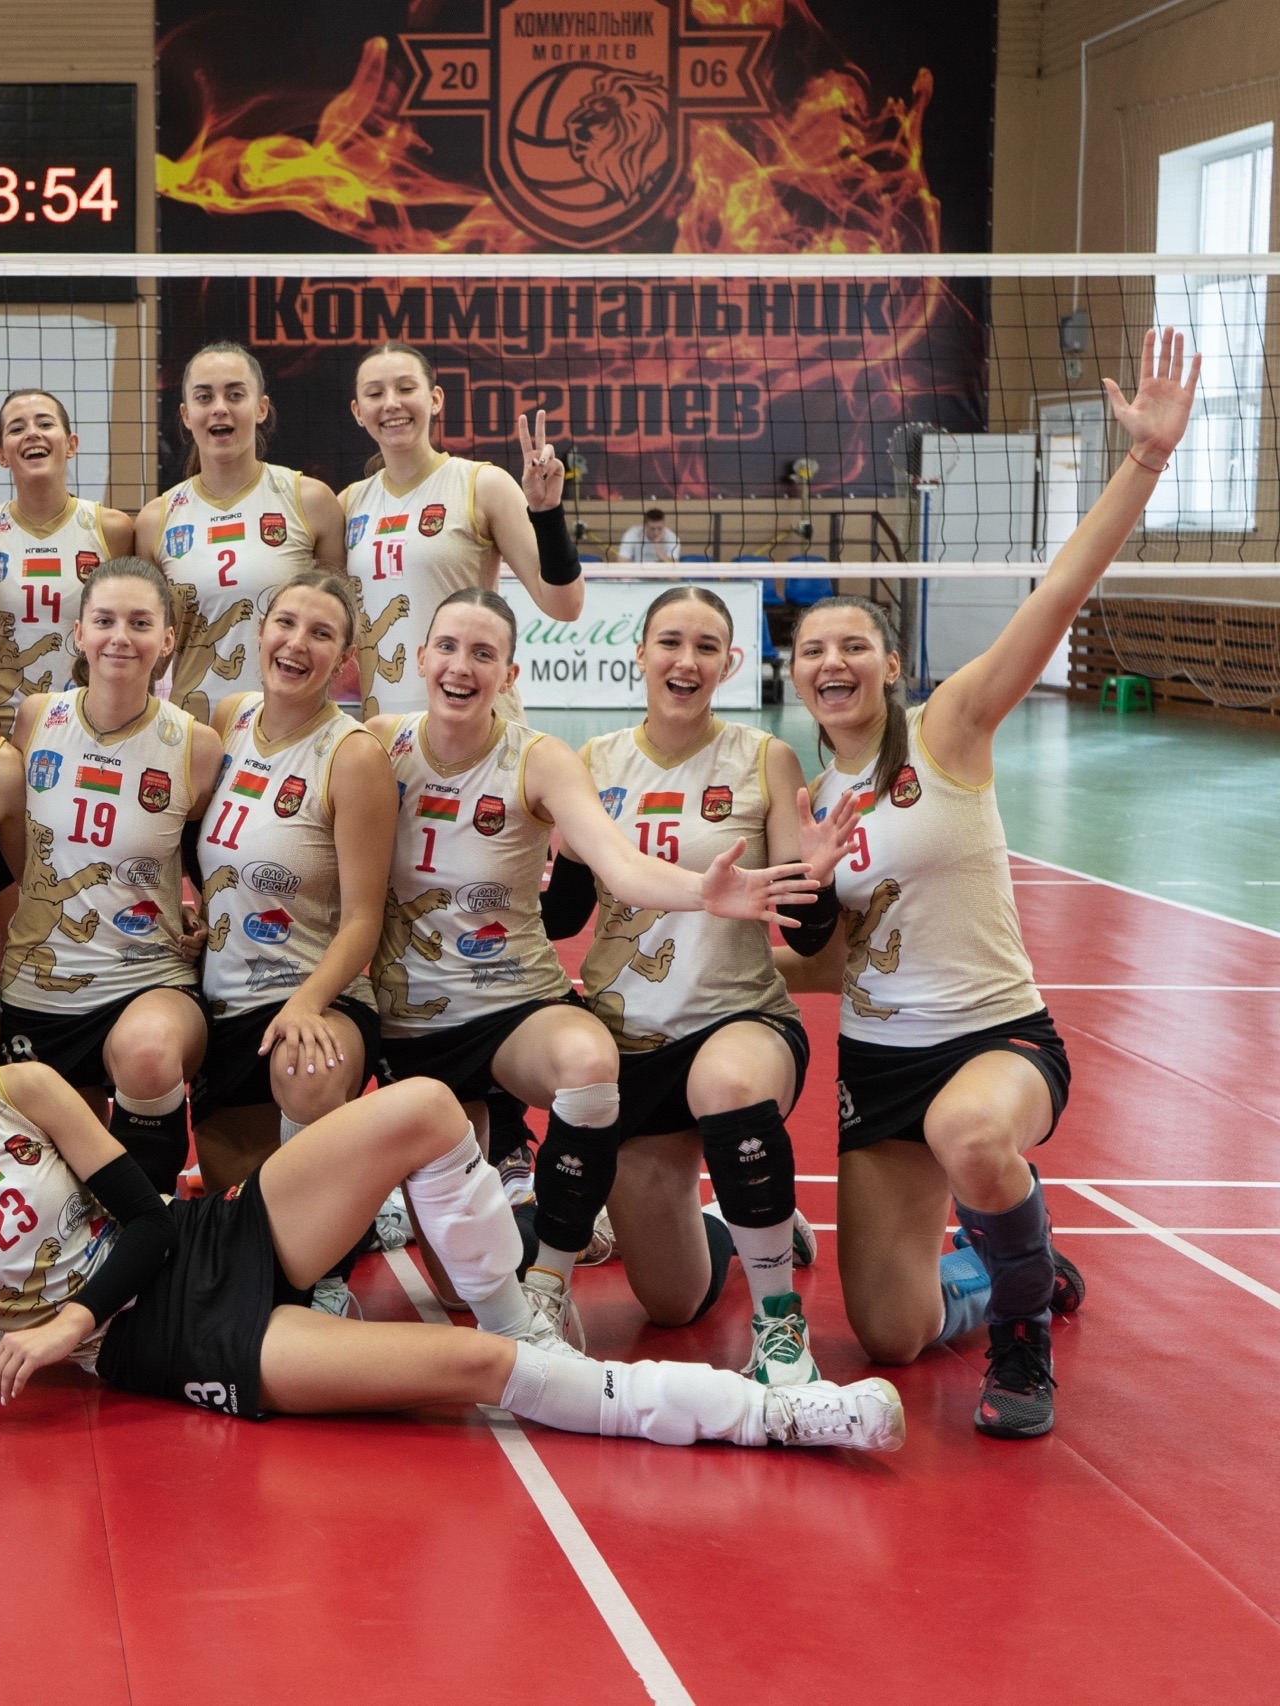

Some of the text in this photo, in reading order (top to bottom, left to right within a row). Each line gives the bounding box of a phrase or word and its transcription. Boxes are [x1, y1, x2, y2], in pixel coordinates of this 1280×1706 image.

[515, 11, 654, 38] КОММУНАЛЬНИК
[533, 44, 637, 61] МОГИЛЕВ
[441, 62, 478, 90] 20
[690, 60, 728, 88] 06
[252, 276, 892, 358] Коммунальник
[217, 549, 238, 588] 2
[21, 584, 61, 624] 14
[531, 650, 587, 681] мой
[67, 797, 117, 848] 19
[206, 800, 250, 851] 11
[415, 827, 437, 874] 1
[635, 821, 681, 865] 15
[261, 868, 285, 880] ОАО
[555, 1162, 583, 1177] errea
[739, 1150, 767, 1163] errea
